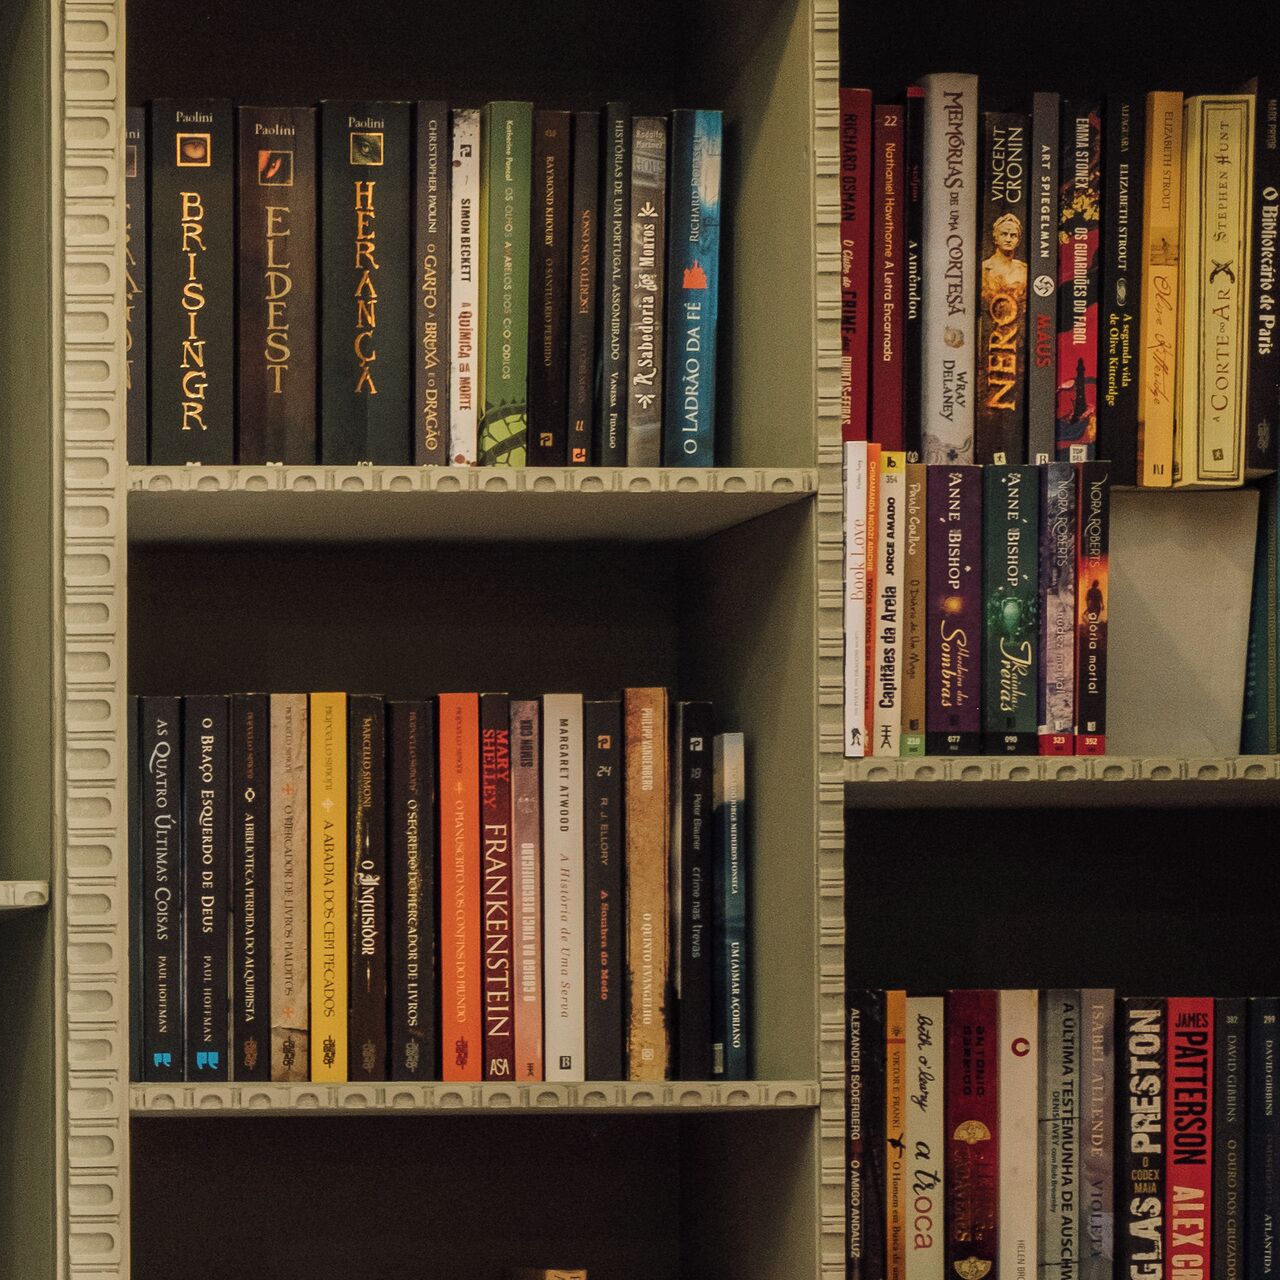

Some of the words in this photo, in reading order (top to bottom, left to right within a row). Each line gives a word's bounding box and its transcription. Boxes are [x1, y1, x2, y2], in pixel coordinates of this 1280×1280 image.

[176, 111, 213, 124] Paolini
[256, 124, 295, 135] Paolini
[348, 118, 384, 129] Paolini
[884, 115, 897, 126] 22
[1076, 118, 1088, 148] EMMA
[992, 126, 1005, 201] VINCENT
[1006, 128, 1022, 203] CRONIN
[1041, 145, 1050, 169] ART
[1076, 151, 1088, 189] STONEX
[1041, 176, 1051, 258] SPIEGELMAN
[180, 192, 207, 430] BRISINGR
[264, 206, 291, 394] ELDEST
[355, 181, 379, 394] HERANÇA
[988, 297, 1019, 410] NERO
[887, 498, 895, 539] AMADO
[949, 474, 961, 521] ANNE
[1007, 474, 1021, 520] ANNE
[886, 543, 895, 576] JORGE
[949, 529, 960, 589] BISHOP
[1007, 528, 1019, 586] BISHOP
[881, 587, 896, 623] Areia
[881, 627, 896, 644] da
[879, 648, 896, 709] Capitães
[203, 717, 212, 729] O
[199, 735, 213, 784] BRAÇO
[559, 718, 568, 780] MARGARET
[199, 788, 213, 866] ESQUERDO
[559, 785, 569, 832] ATWOOD
[202, 871, 212, 889] DE
[201, 896, 213, 933] DEUS
[484, 824, 510, 1037] FRANKENSTEIN
[1175, 1013, 1209, 1028] JAMES
[1129, 1010, 1162, 1153] PRESTON
[1173, 1032, 1209, 1165] PATTERSON
[1172, 1186, 1205, 1247] ALEX
